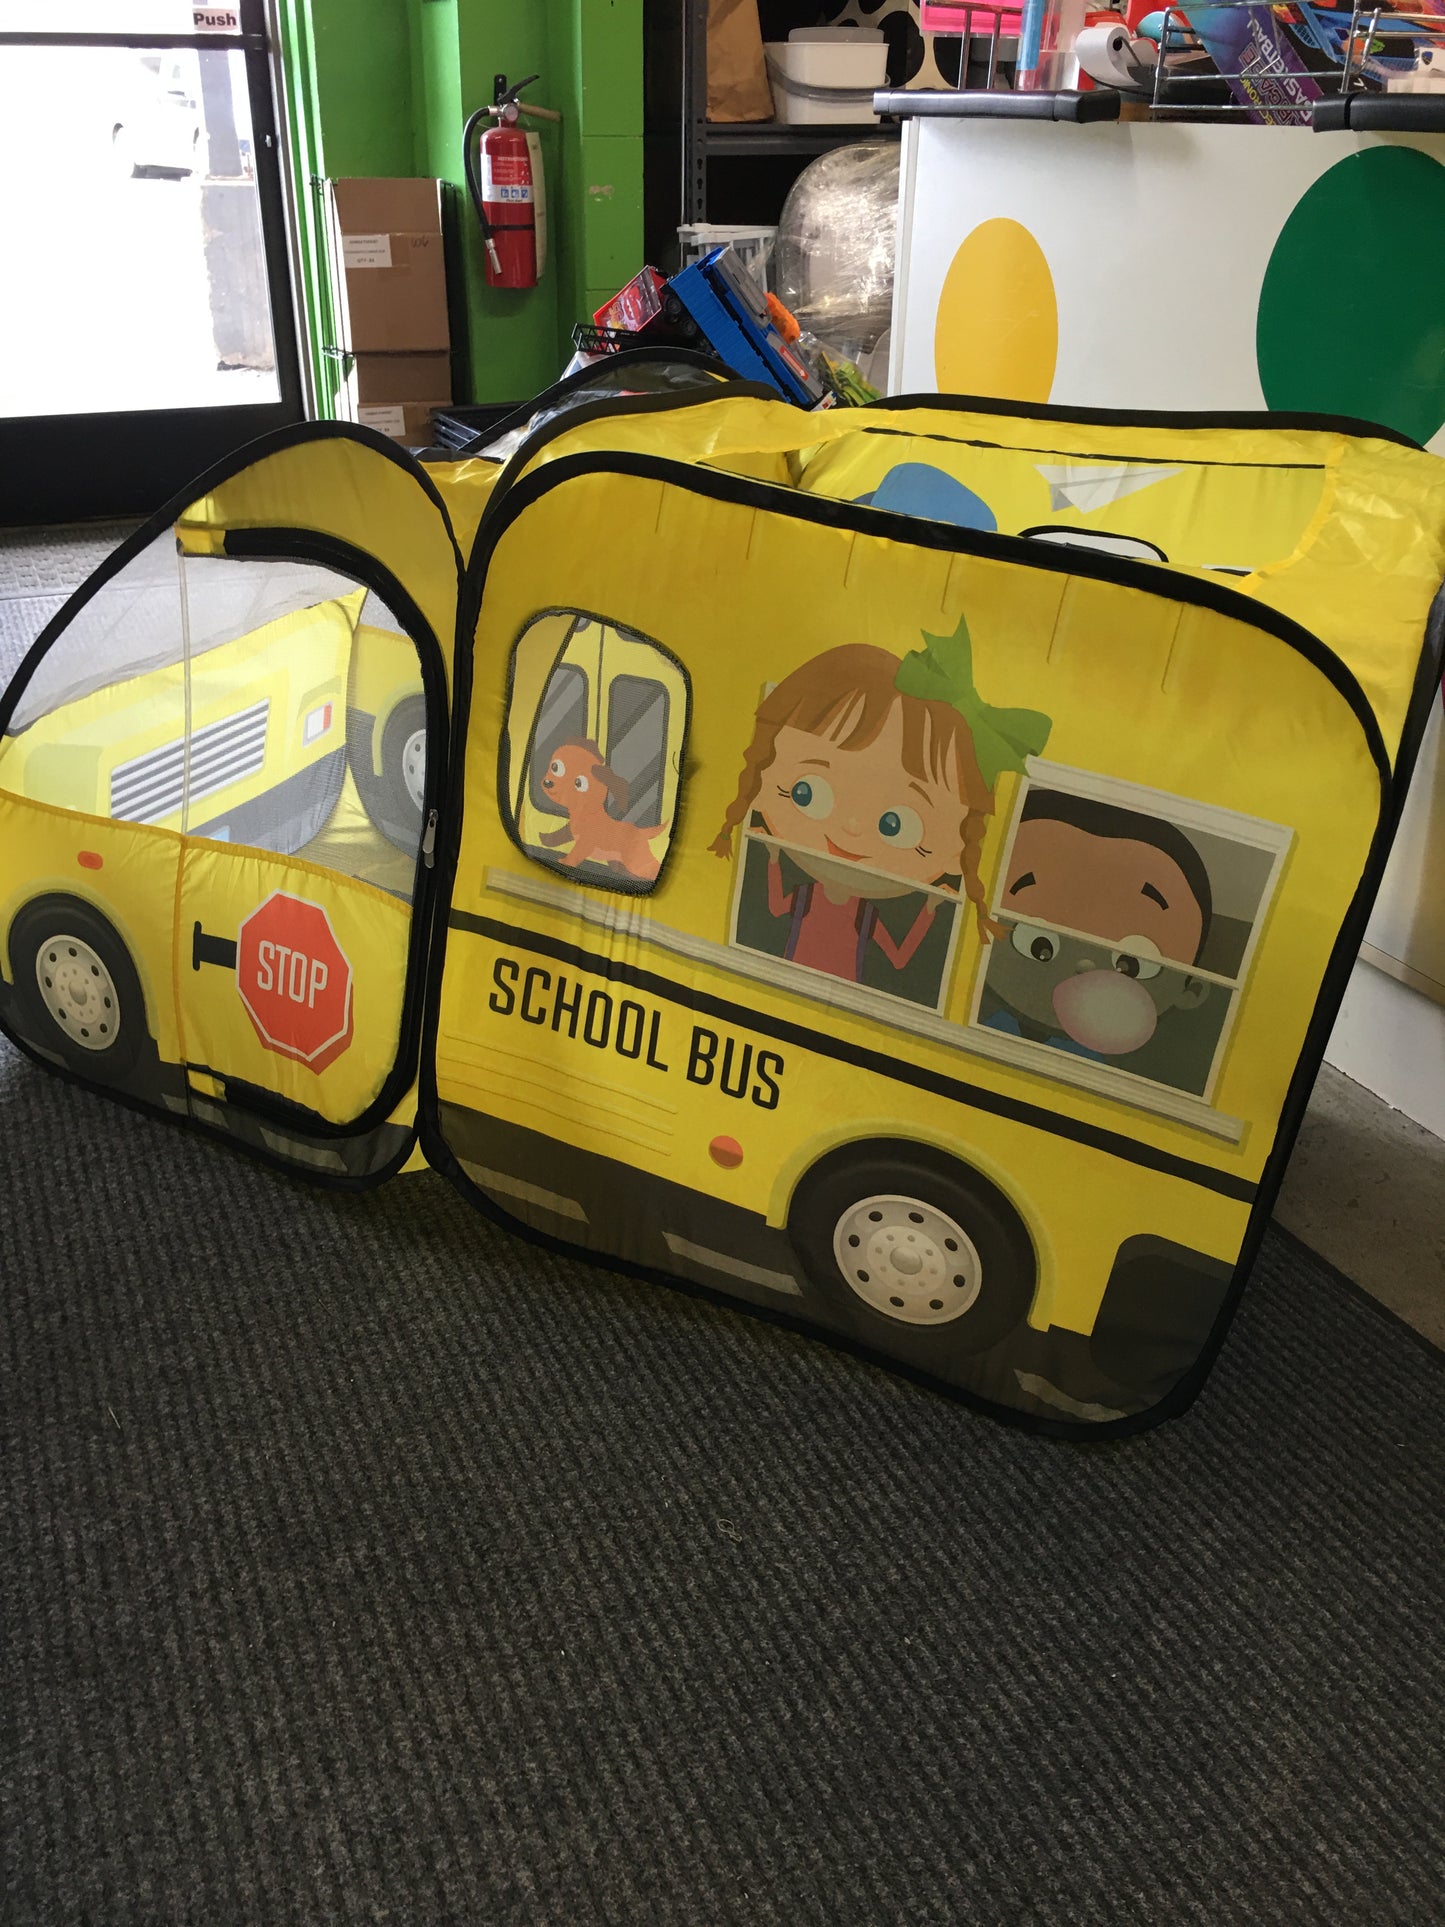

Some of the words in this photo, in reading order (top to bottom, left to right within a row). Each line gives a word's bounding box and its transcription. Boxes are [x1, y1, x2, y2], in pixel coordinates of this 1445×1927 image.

[193, 12, 237, 26] Push
[257, 939, 329, 1009] STOP
[488, 957, 669, 1073] SCHOOL
[686, 1025, 785, 1111] BUS
